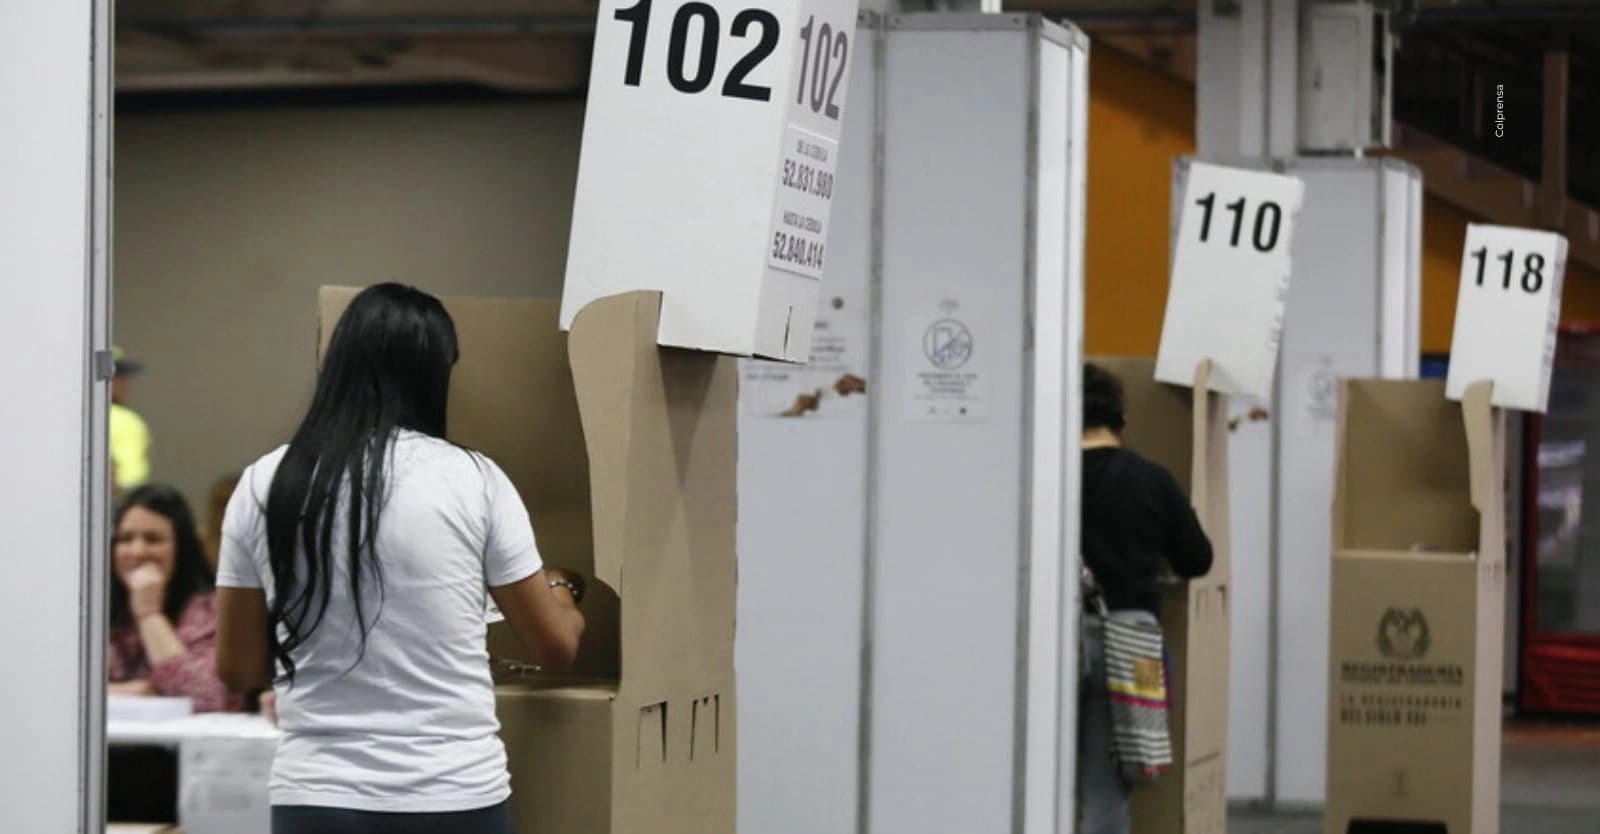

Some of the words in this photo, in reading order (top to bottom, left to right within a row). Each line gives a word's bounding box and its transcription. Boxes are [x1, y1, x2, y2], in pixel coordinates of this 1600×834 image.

[614, 0, 780, 102] 102
[797, 15, 848, 121] 102
[1196, 191, 1282, 253] 110
[1471, 245, 1545, 293] 118
